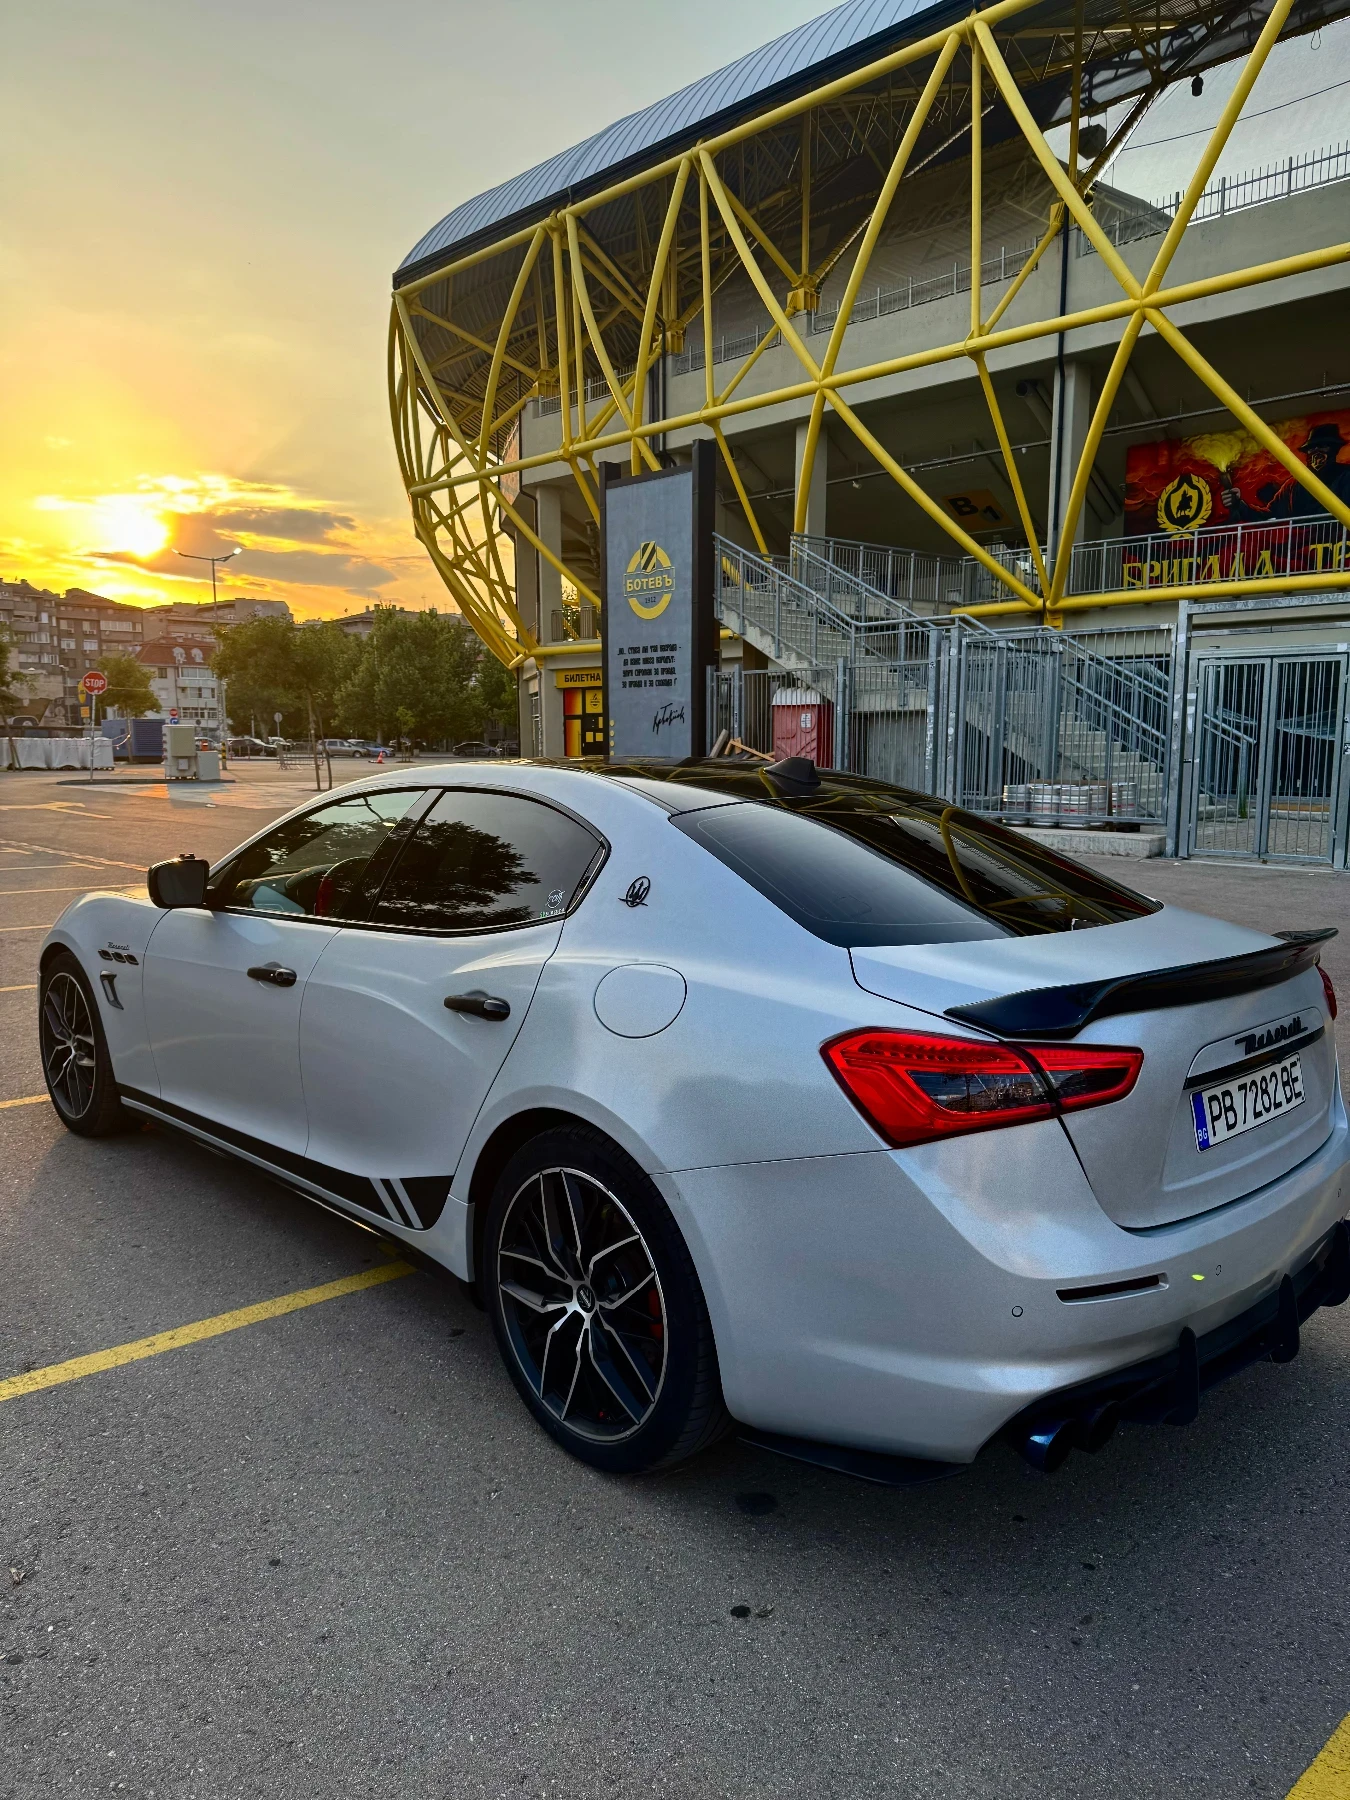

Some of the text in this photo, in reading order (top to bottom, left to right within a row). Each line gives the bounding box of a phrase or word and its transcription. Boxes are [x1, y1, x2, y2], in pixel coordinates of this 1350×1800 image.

[626, 574, 673, 592] БОТЕВЪ
[644, 596, 657, 604] 1912
[85, 678, 105, 688] STOP
[564, 672, 602, 683] БИЛЕТНА
[1207, 1061, 1302, 1137] PB 7282 BE
[1197, 1127, 1208, 1142] BG
